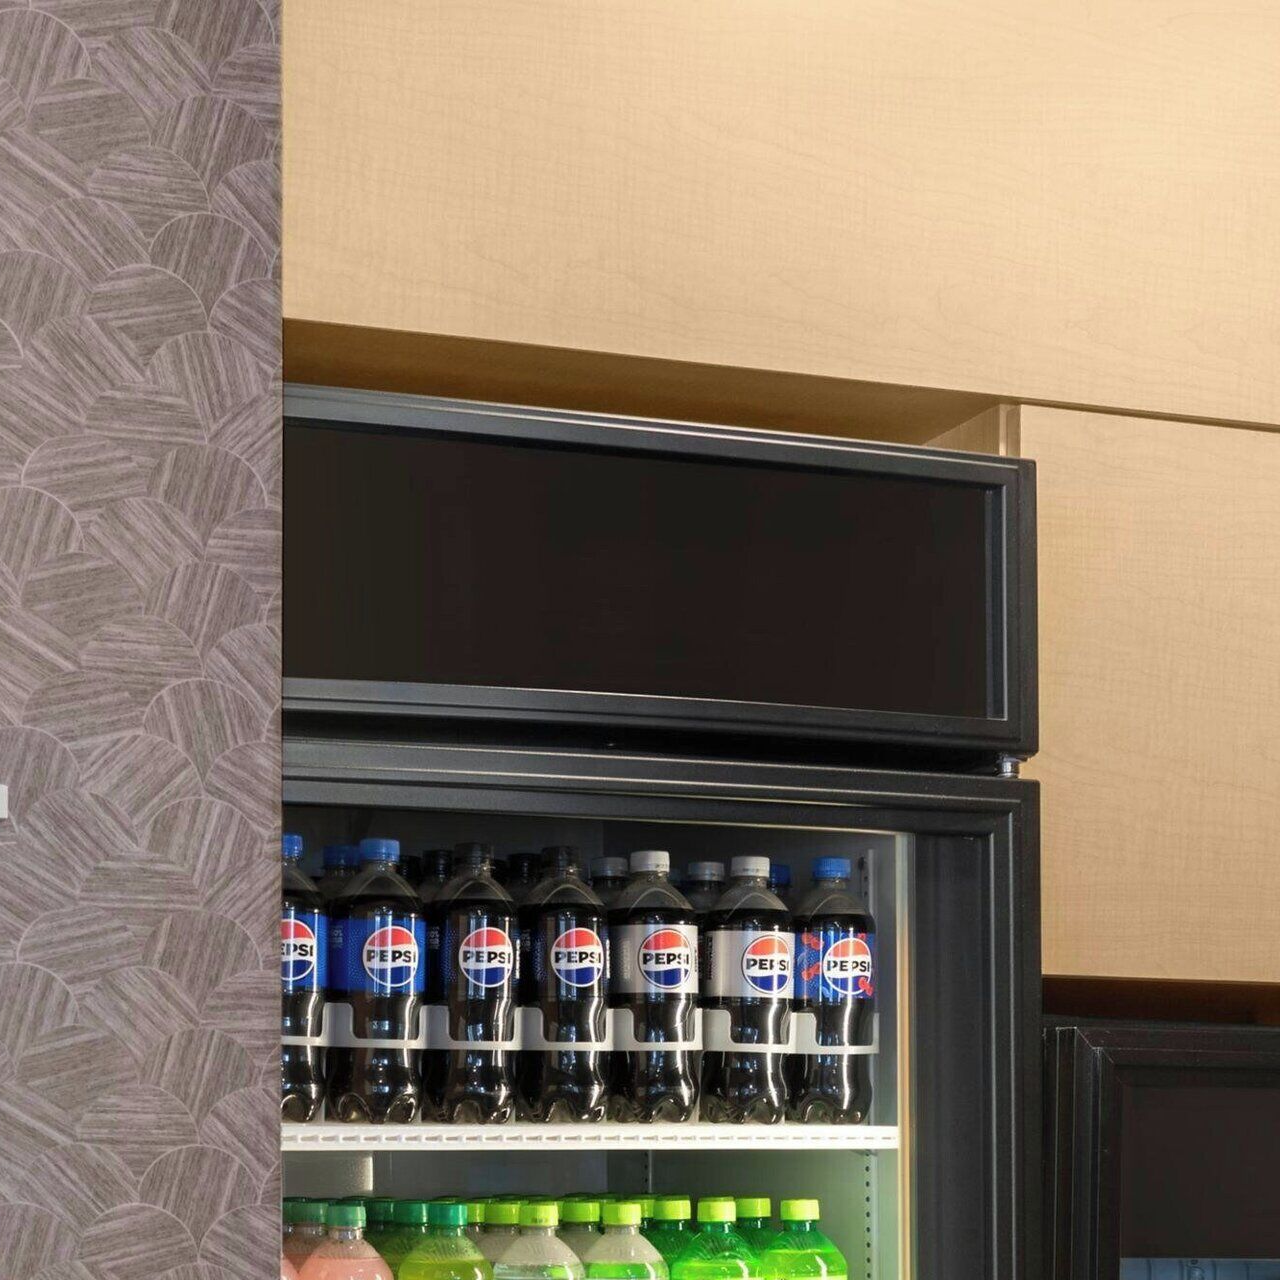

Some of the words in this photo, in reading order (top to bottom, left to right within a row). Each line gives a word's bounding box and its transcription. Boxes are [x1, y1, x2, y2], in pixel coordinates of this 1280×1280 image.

[281, 942, 313, 957] EPSI
[366, 949, 416, 964] PEPSI
[462, 949, 511, 964] PEPSI
[554, 949, 601, 964] PEPSI
[642, 952, 690, 966] PEPSI
[826, 959, 870, 973] PEPSI
